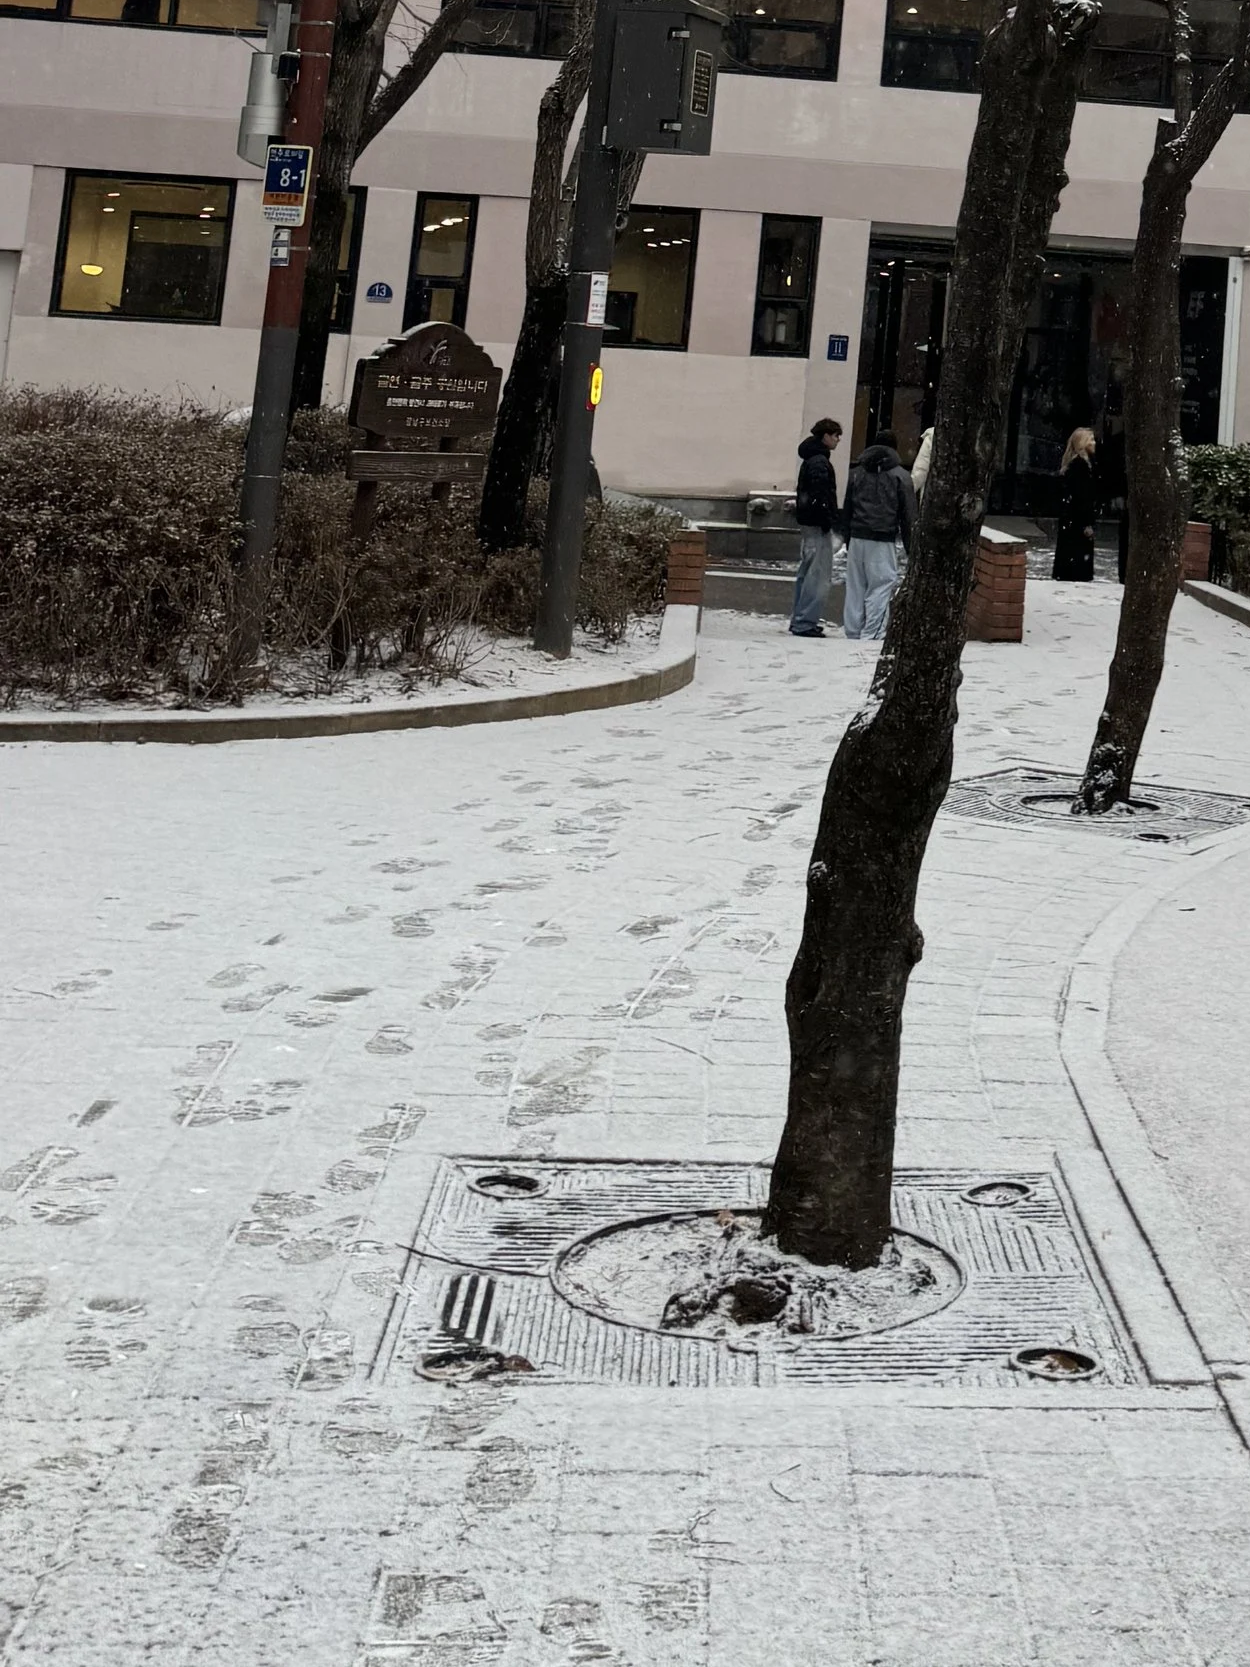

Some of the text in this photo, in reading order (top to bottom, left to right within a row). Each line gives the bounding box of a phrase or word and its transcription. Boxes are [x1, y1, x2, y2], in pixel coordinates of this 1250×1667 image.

[279, 168, 306, 188] 8-1
[373, 284, 387, 297] 13
[377, 374, 489, 394] 금연 금주 공원입니다
